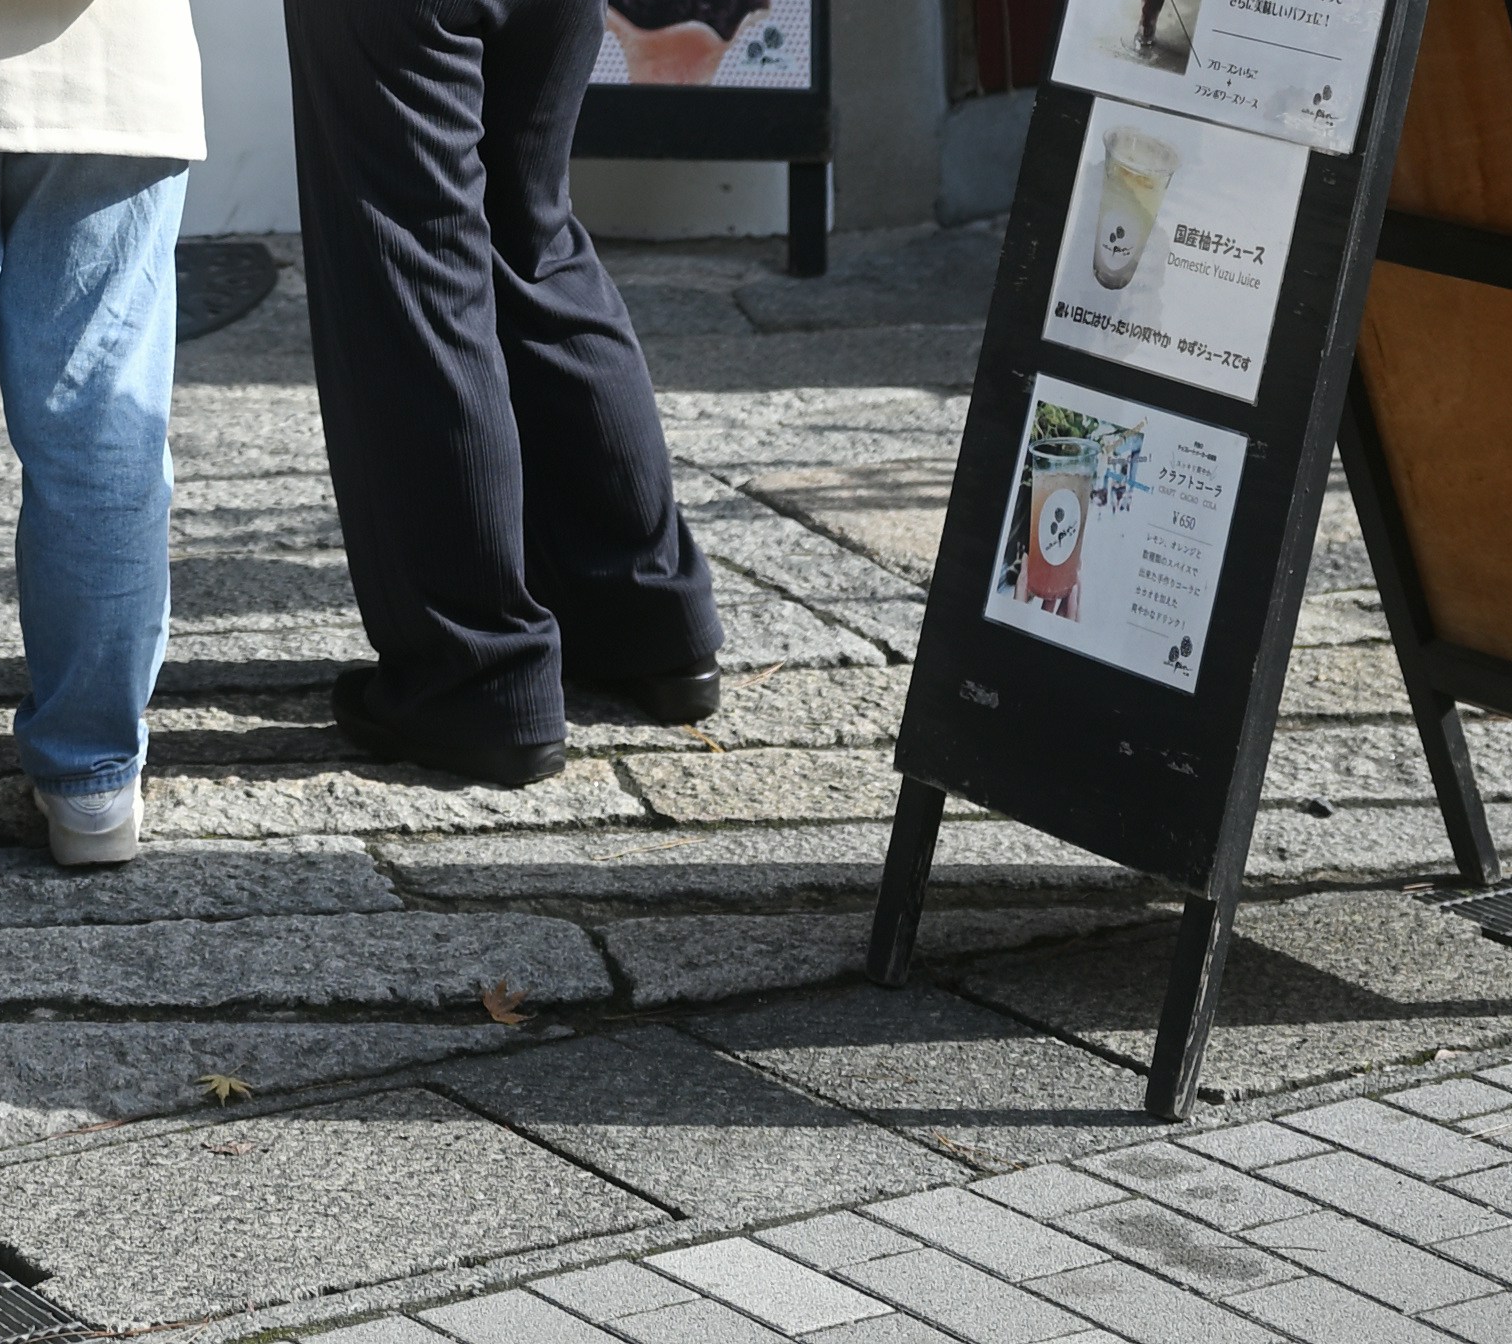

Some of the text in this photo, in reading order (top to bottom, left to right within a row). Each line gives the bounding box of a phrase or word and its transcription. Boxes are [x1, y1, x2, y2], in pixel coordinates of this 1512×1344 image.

[1174, 223, 1266, 265] 国産柚子ジュース
[1167, 251, 1261, 289] Domestic Yuzu Juice
[1158, 467, 1223, 498] クラフトコーラ
